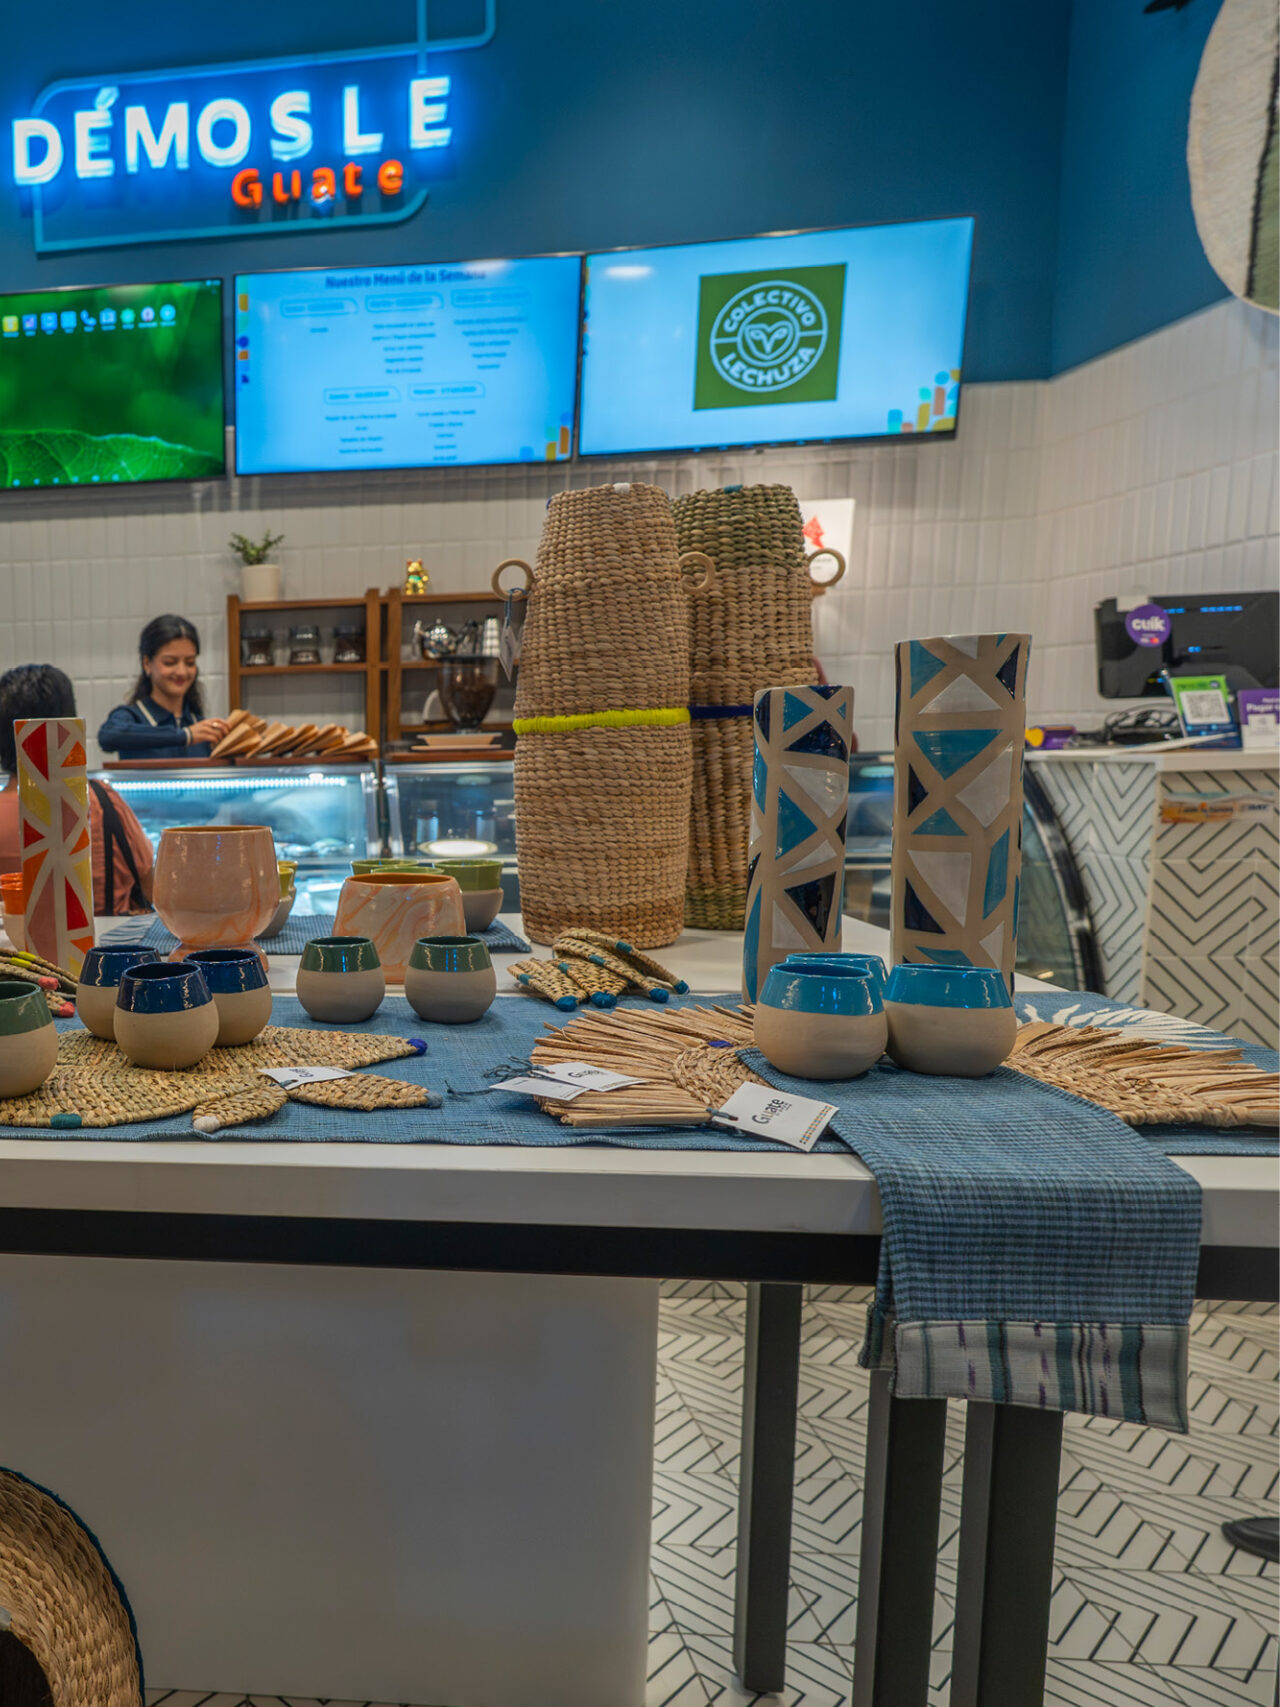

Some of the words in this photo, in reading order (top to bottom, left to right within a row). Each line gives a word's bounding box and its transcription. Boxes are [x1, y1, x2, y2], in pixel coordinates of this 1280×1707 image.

[231, 158, 405, 209] Guate
[325, 275, 370, 288] Nuestro
[373, 270, 405, 285] Menú
[408, 271, 423, 284] de
[424, 269, 437, 282] la
[723, 289, 817, 333] COLECTIVO
[721, 347, 816, 386] LECHUZA
[1131, 615, 1166, 632] cuik
[752, 1099, 784, 1124] Guate
